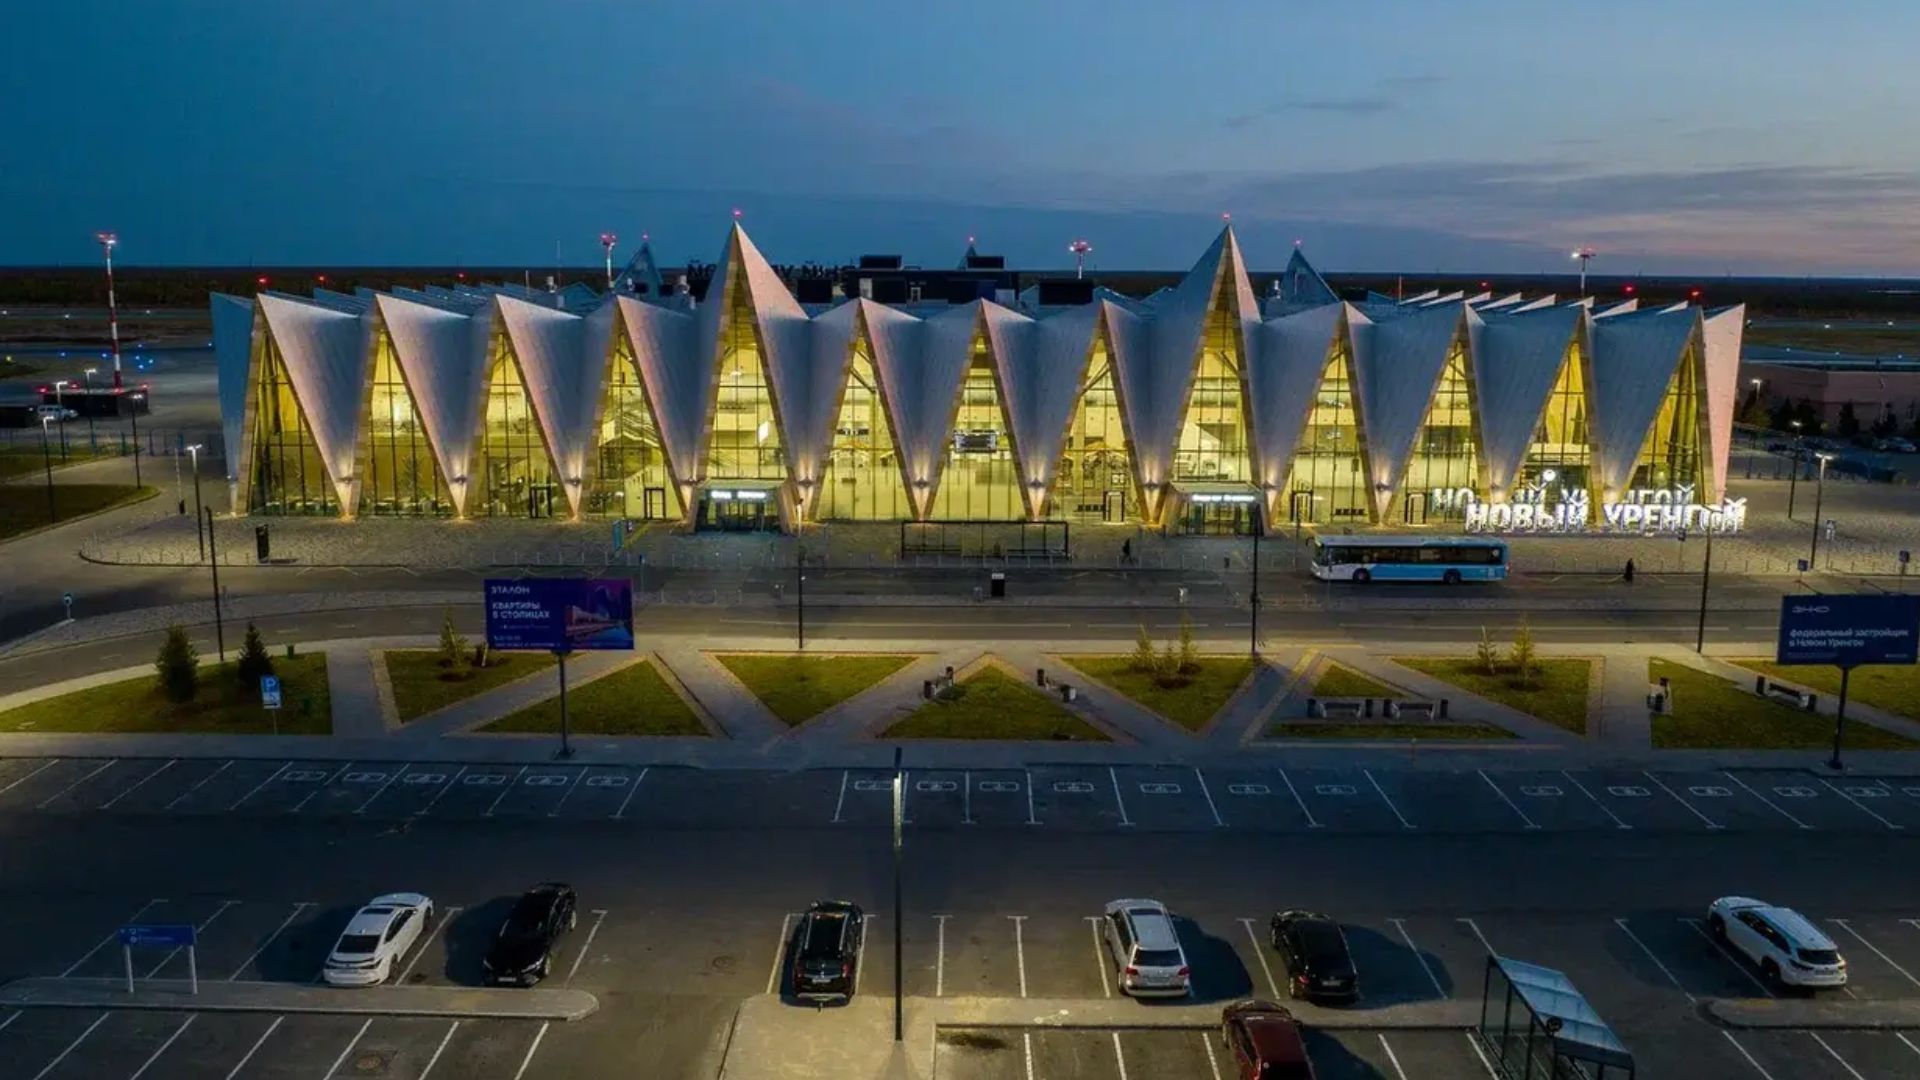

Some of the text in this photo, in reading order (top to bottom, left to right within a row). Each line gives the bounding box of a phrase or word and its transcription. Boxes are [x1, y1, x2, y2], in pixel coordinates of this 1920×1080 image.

[1465, 496, 1748, 531] НОВЫЙ УРЕНГОЙ
[490, 585, 530, 595] ЭТАЛОН
[492, 601, 541, 610] КВАРТИРЫ
[500, 610, 551, 619] СТОЛИЦАХ
[1789, 628, 1909, 638] федеральный застройщик
[1796, 638, 1826, 647] Новом
